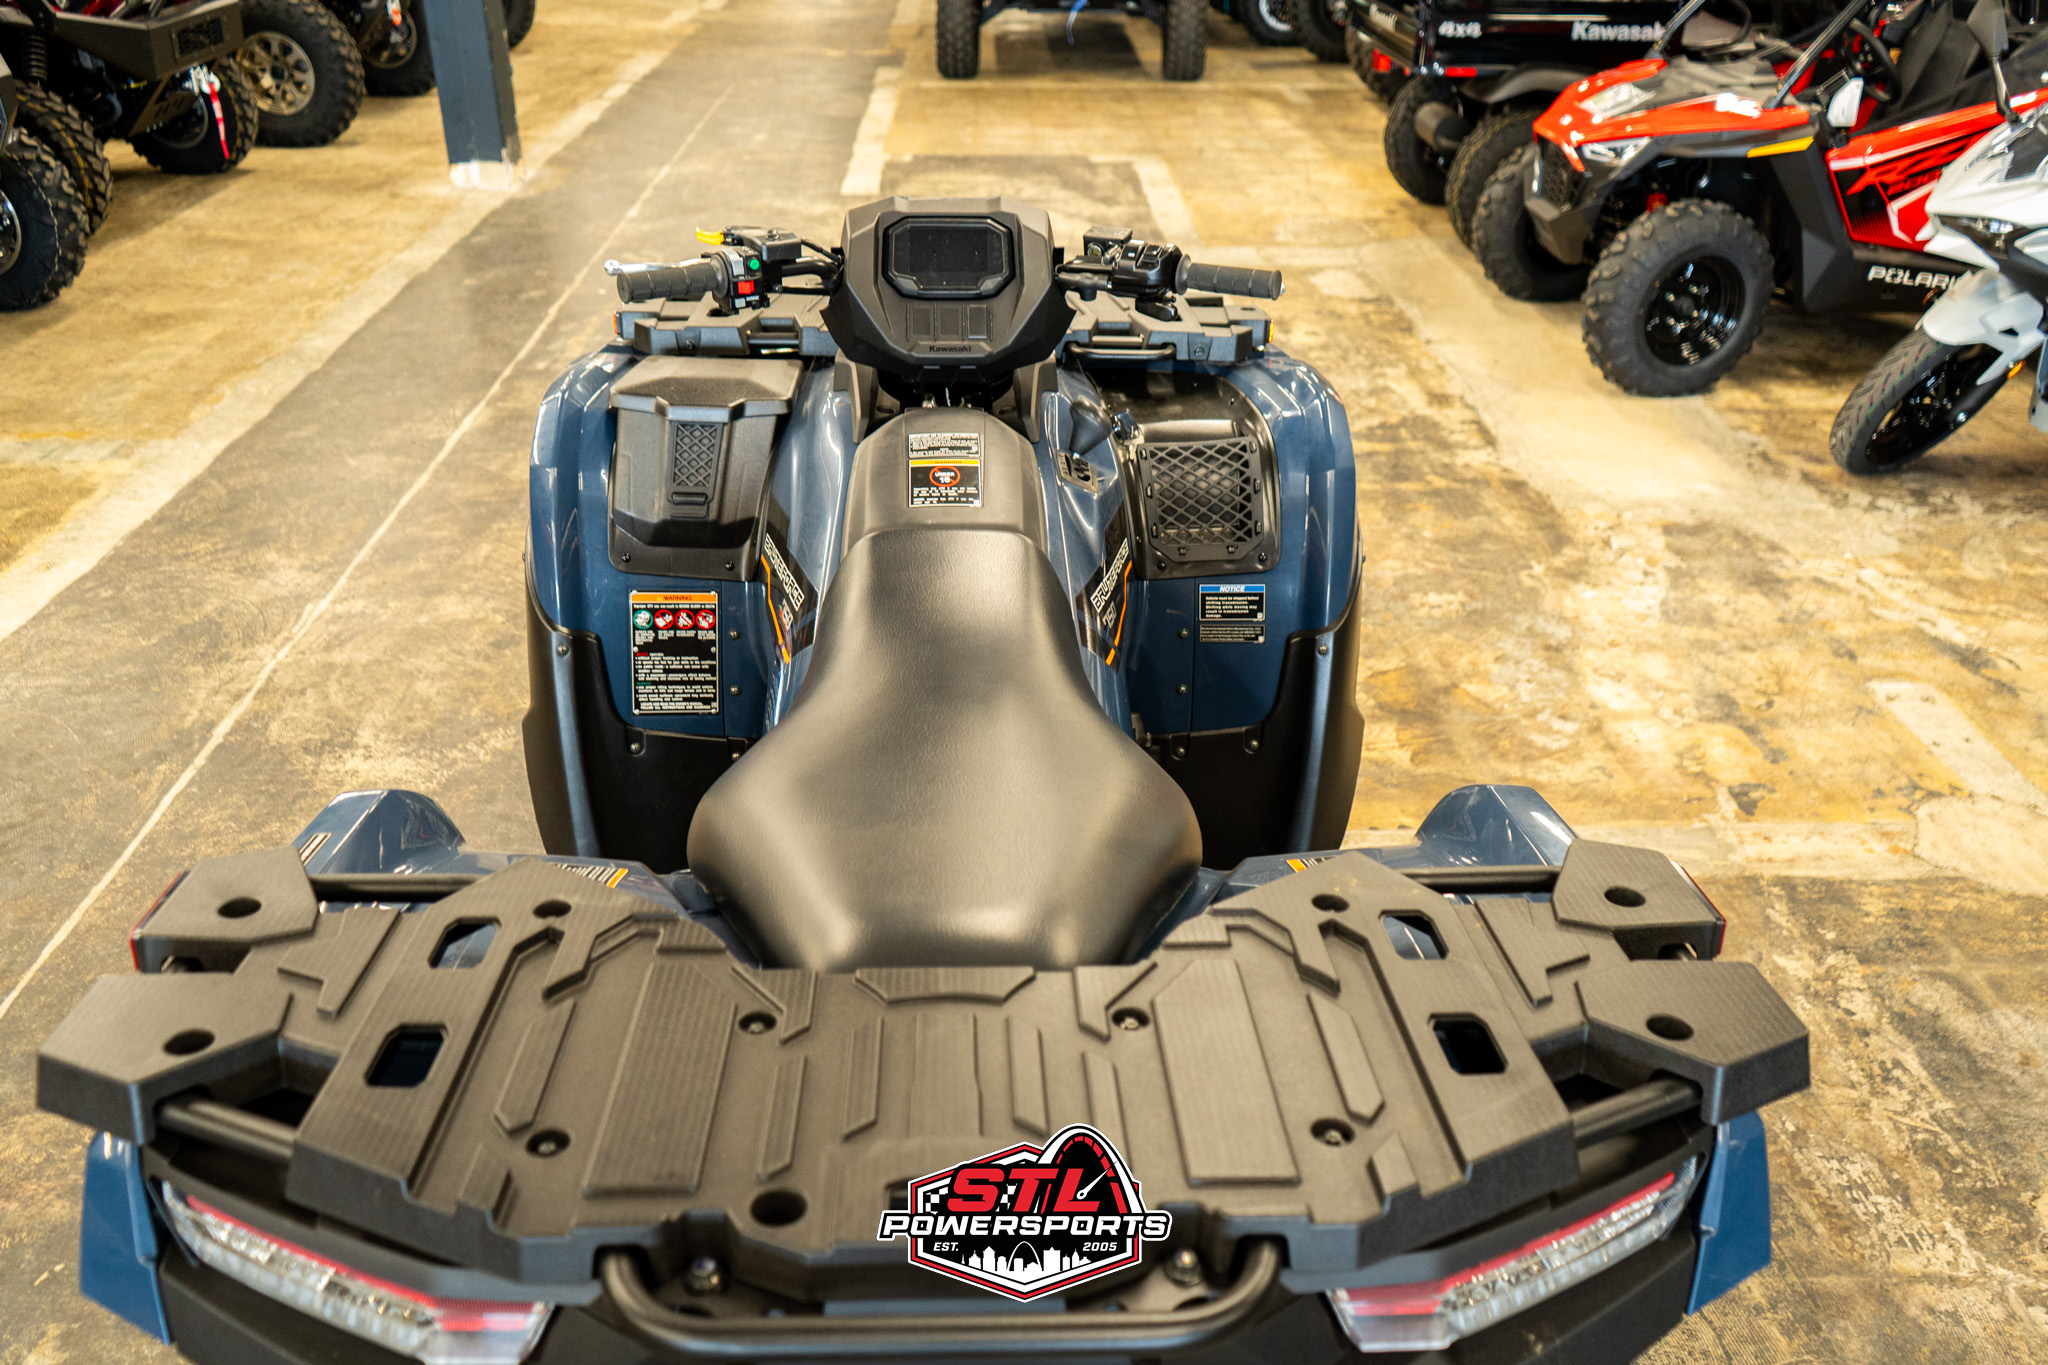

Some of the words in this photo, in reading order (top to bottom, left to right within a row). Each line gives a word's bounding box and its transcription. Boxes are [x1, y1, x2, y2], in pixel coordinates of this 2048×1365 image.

[1438, 21, 1482, 38] 4x4
[1571, 20, 1666, 41] Kawasak
[1867, 265, 1957, 290] POLARI
[929, 345, 972, 353] Kawasaki
